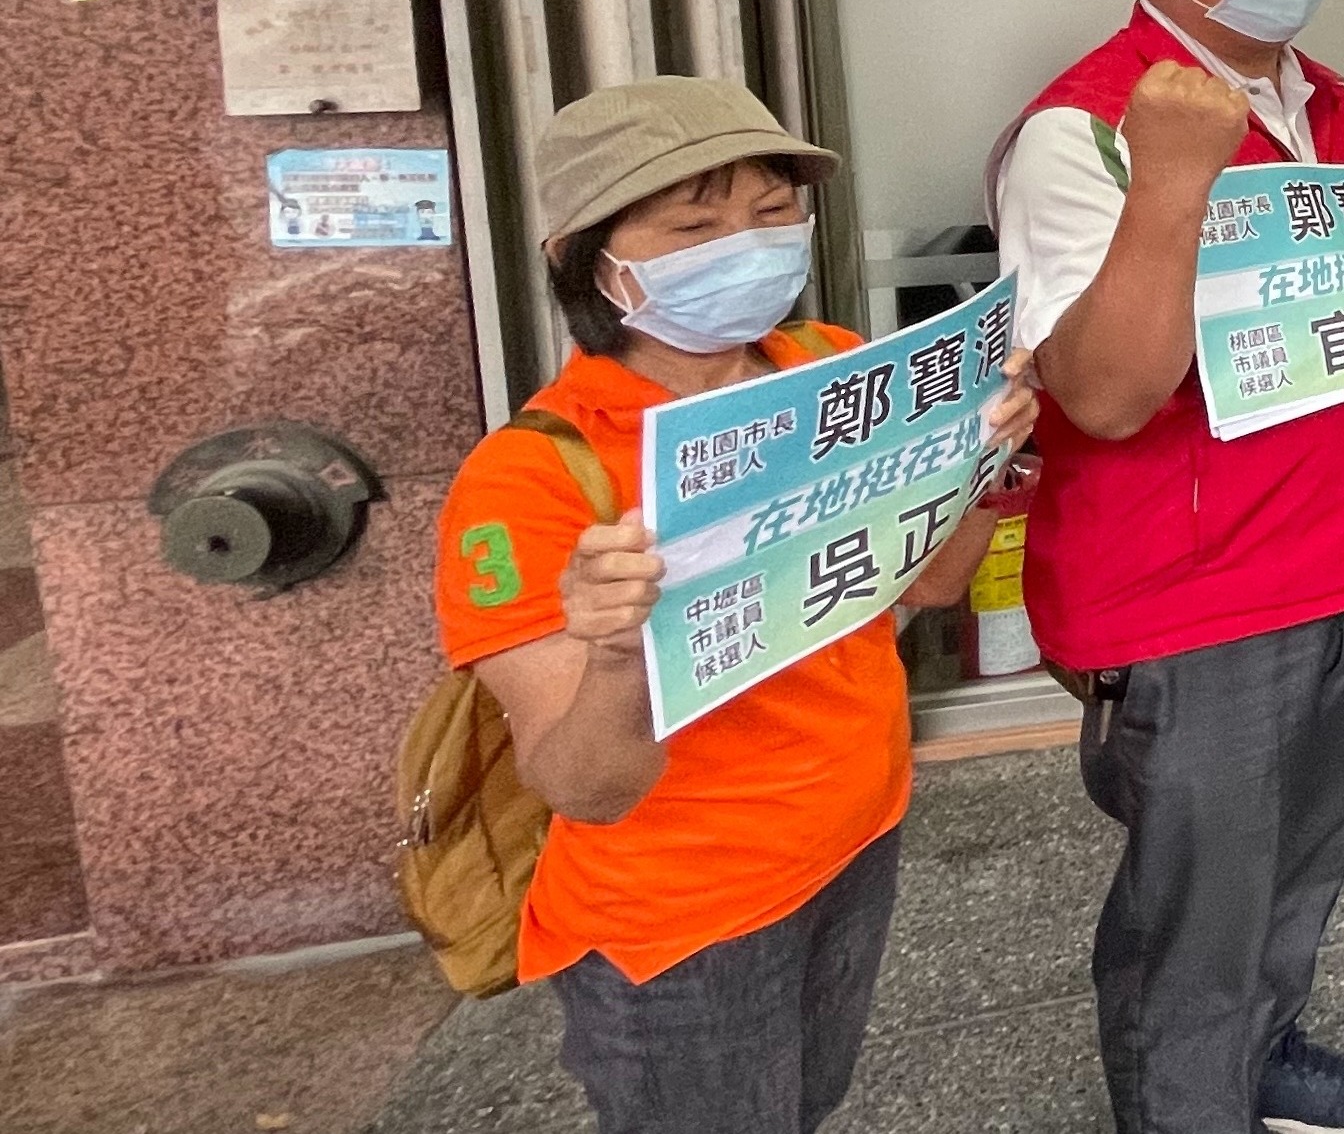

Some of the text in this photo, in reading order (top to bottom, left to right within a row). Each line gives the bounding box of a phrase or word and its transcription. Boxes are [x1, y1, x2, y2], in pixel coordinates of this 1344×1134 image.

[1201, 221, 1259, 246] 候選人
[1230, 325, 1284, 350] 桃園區
[1234, 347, 1290, 373] 市議員
[812, 298, 1012, 460] 鄭寶清
[1239, 371, 1294, 398] 候選人
[679, 409, 796, 468] 桃園市長
[679, 454, 767, 498] 候選人
[745, 419, 982, 555] 在地挺在地
[461, 524, 523, 608] 3
[686, 572, 766, 623] 中壢區
[690, 606, 767, 654] 市議員
[694, 636, 769, 686] 候選人
